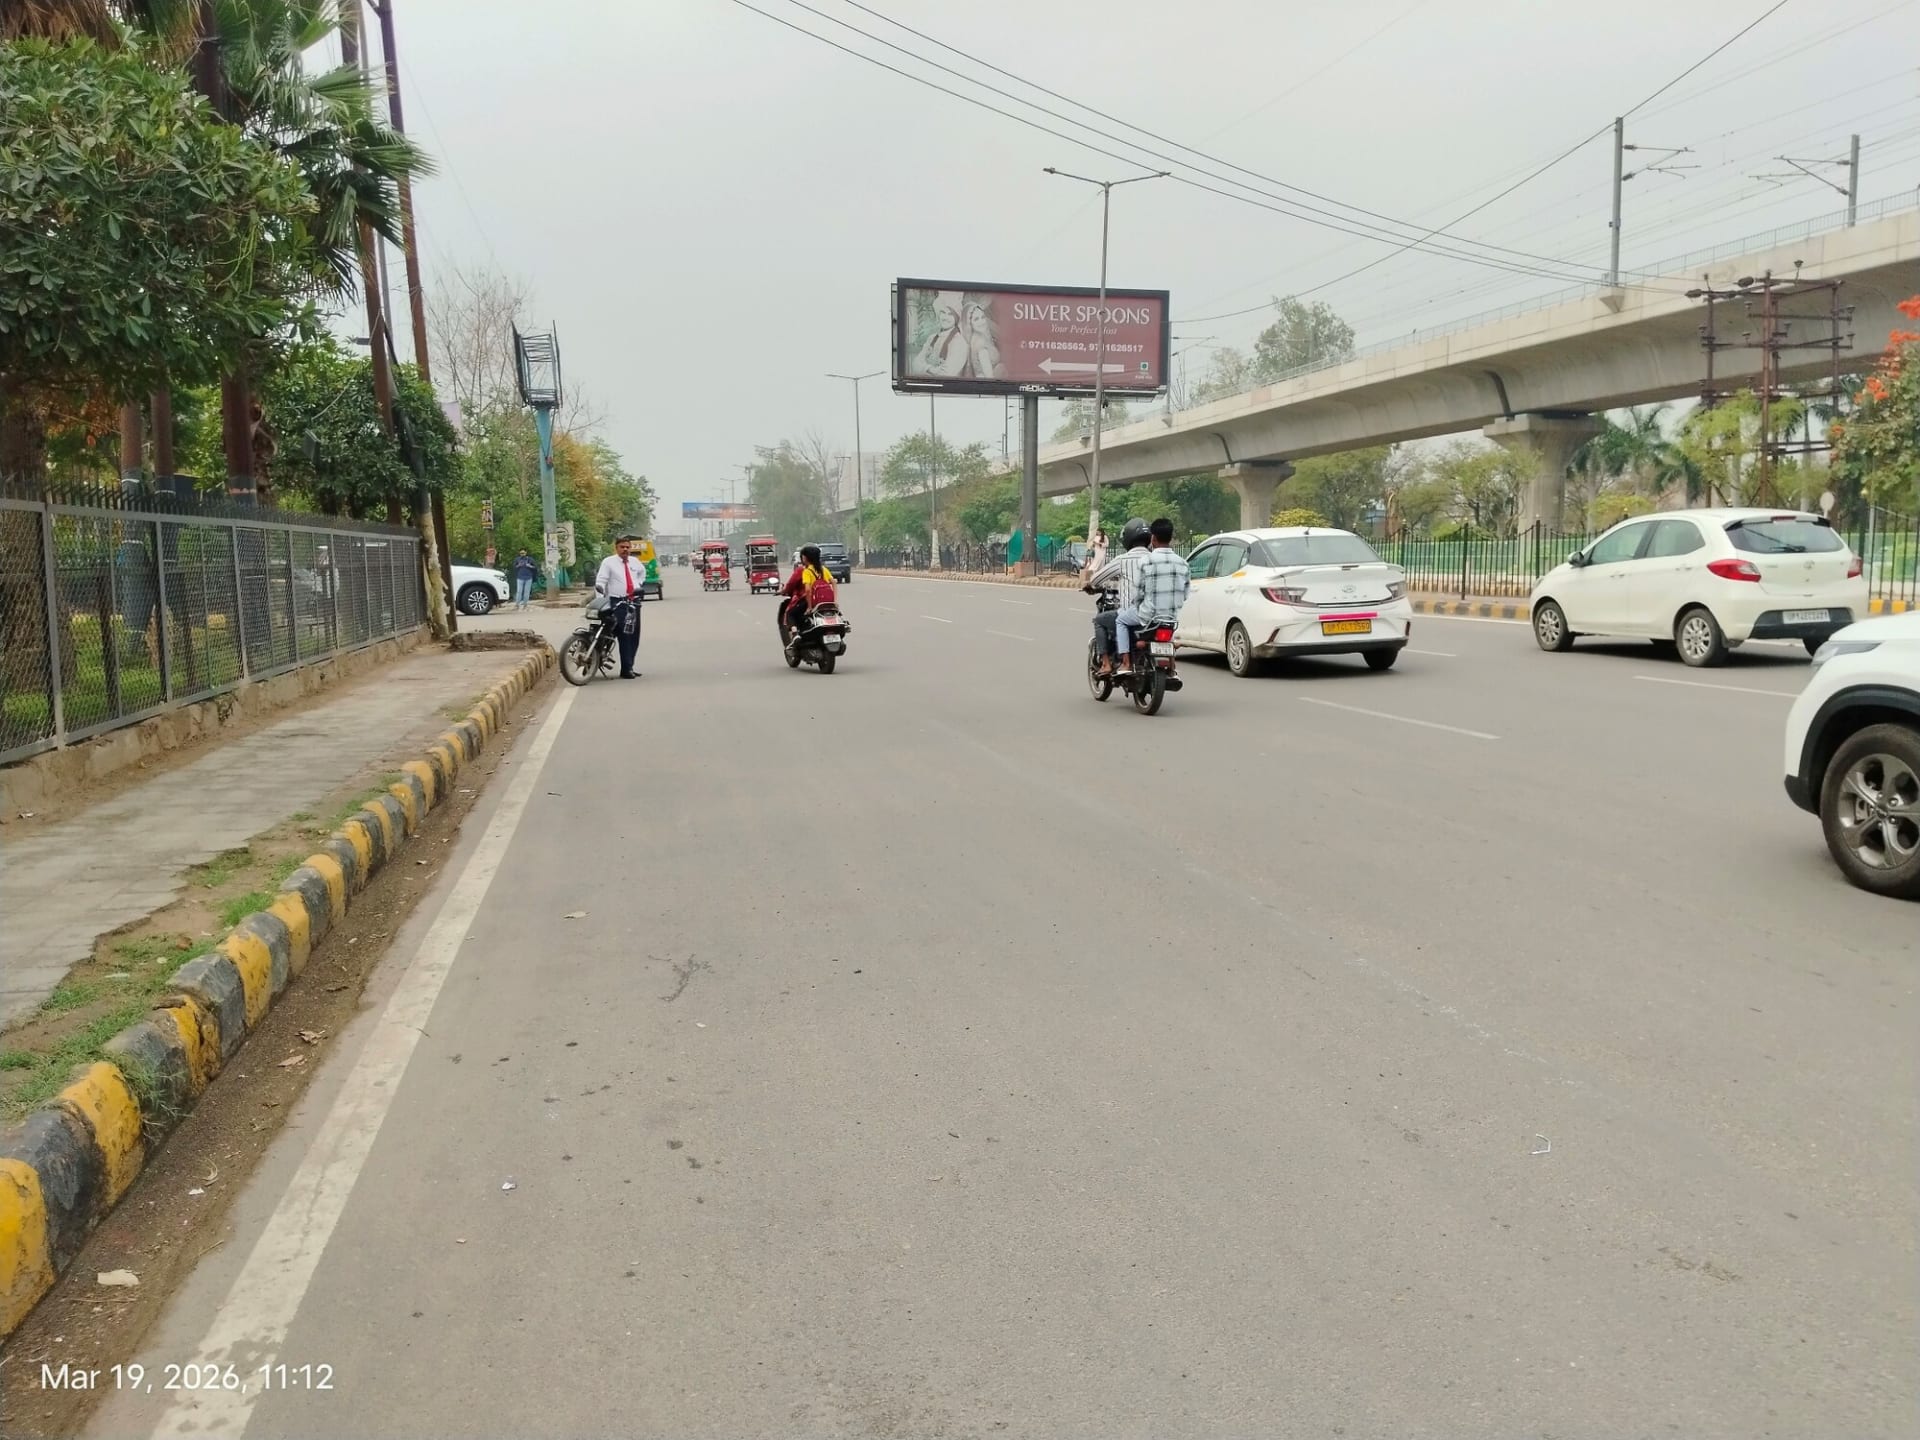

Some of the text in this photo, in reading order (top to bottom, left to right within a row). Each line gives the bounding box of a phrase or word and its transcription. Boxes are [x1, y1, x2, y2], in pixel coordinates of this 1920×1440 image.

[1013, 302, 1150, 325] SILVER SPOONS
[1051, 324, 1068, 333] Your
[1070, 325, 1098, 335] Perfect
